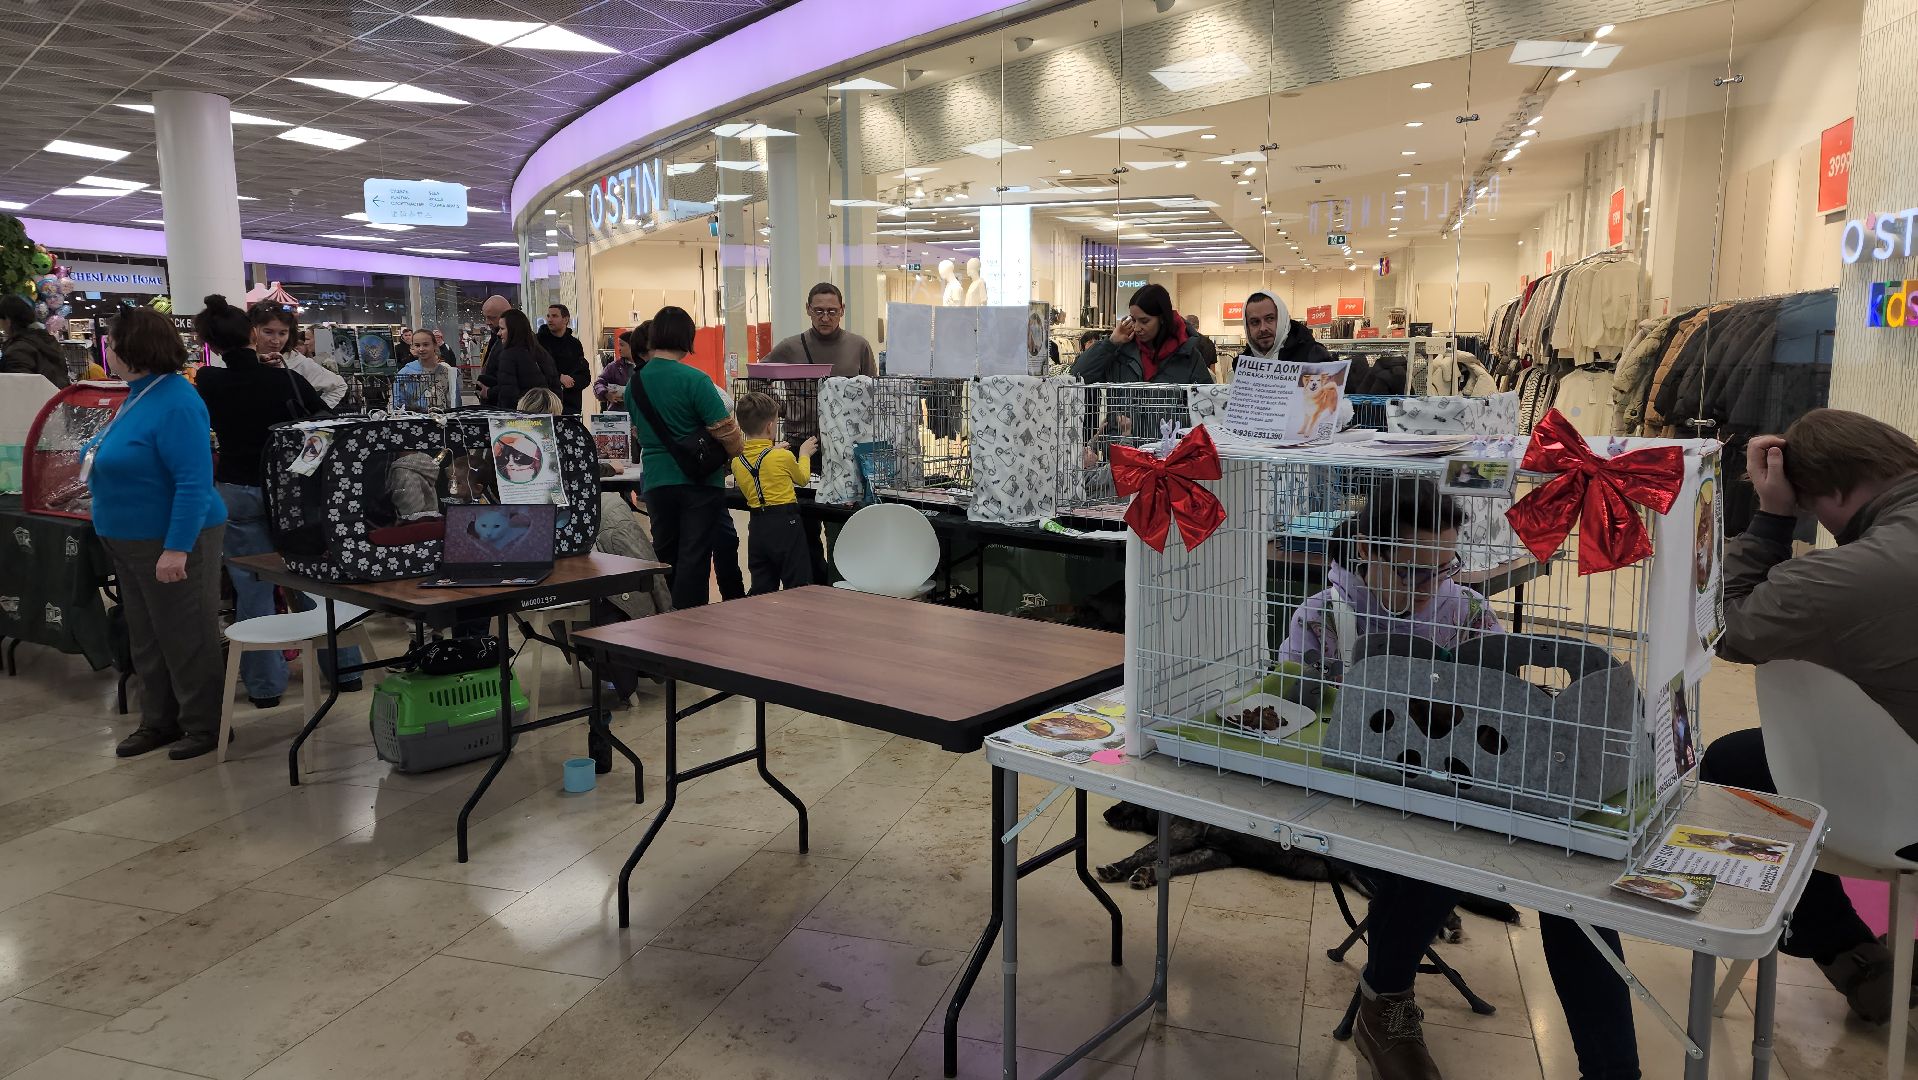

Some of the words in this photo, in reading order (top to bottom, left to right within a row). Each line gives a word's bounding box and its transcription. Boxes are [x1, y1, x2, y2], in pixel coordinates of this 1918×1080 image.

[590, 158, 661, 230] O'STIN
[69, 271, 128, 284] CHENLAND
[132, 274, 163, 285] HOME
[1239, 358, 1272, 372] ИЩЕТ
[1274, 364, 1300, 374] ДОМ
[1237, 370, 1297, 382] СОБАКА-УЛЫБАКА
